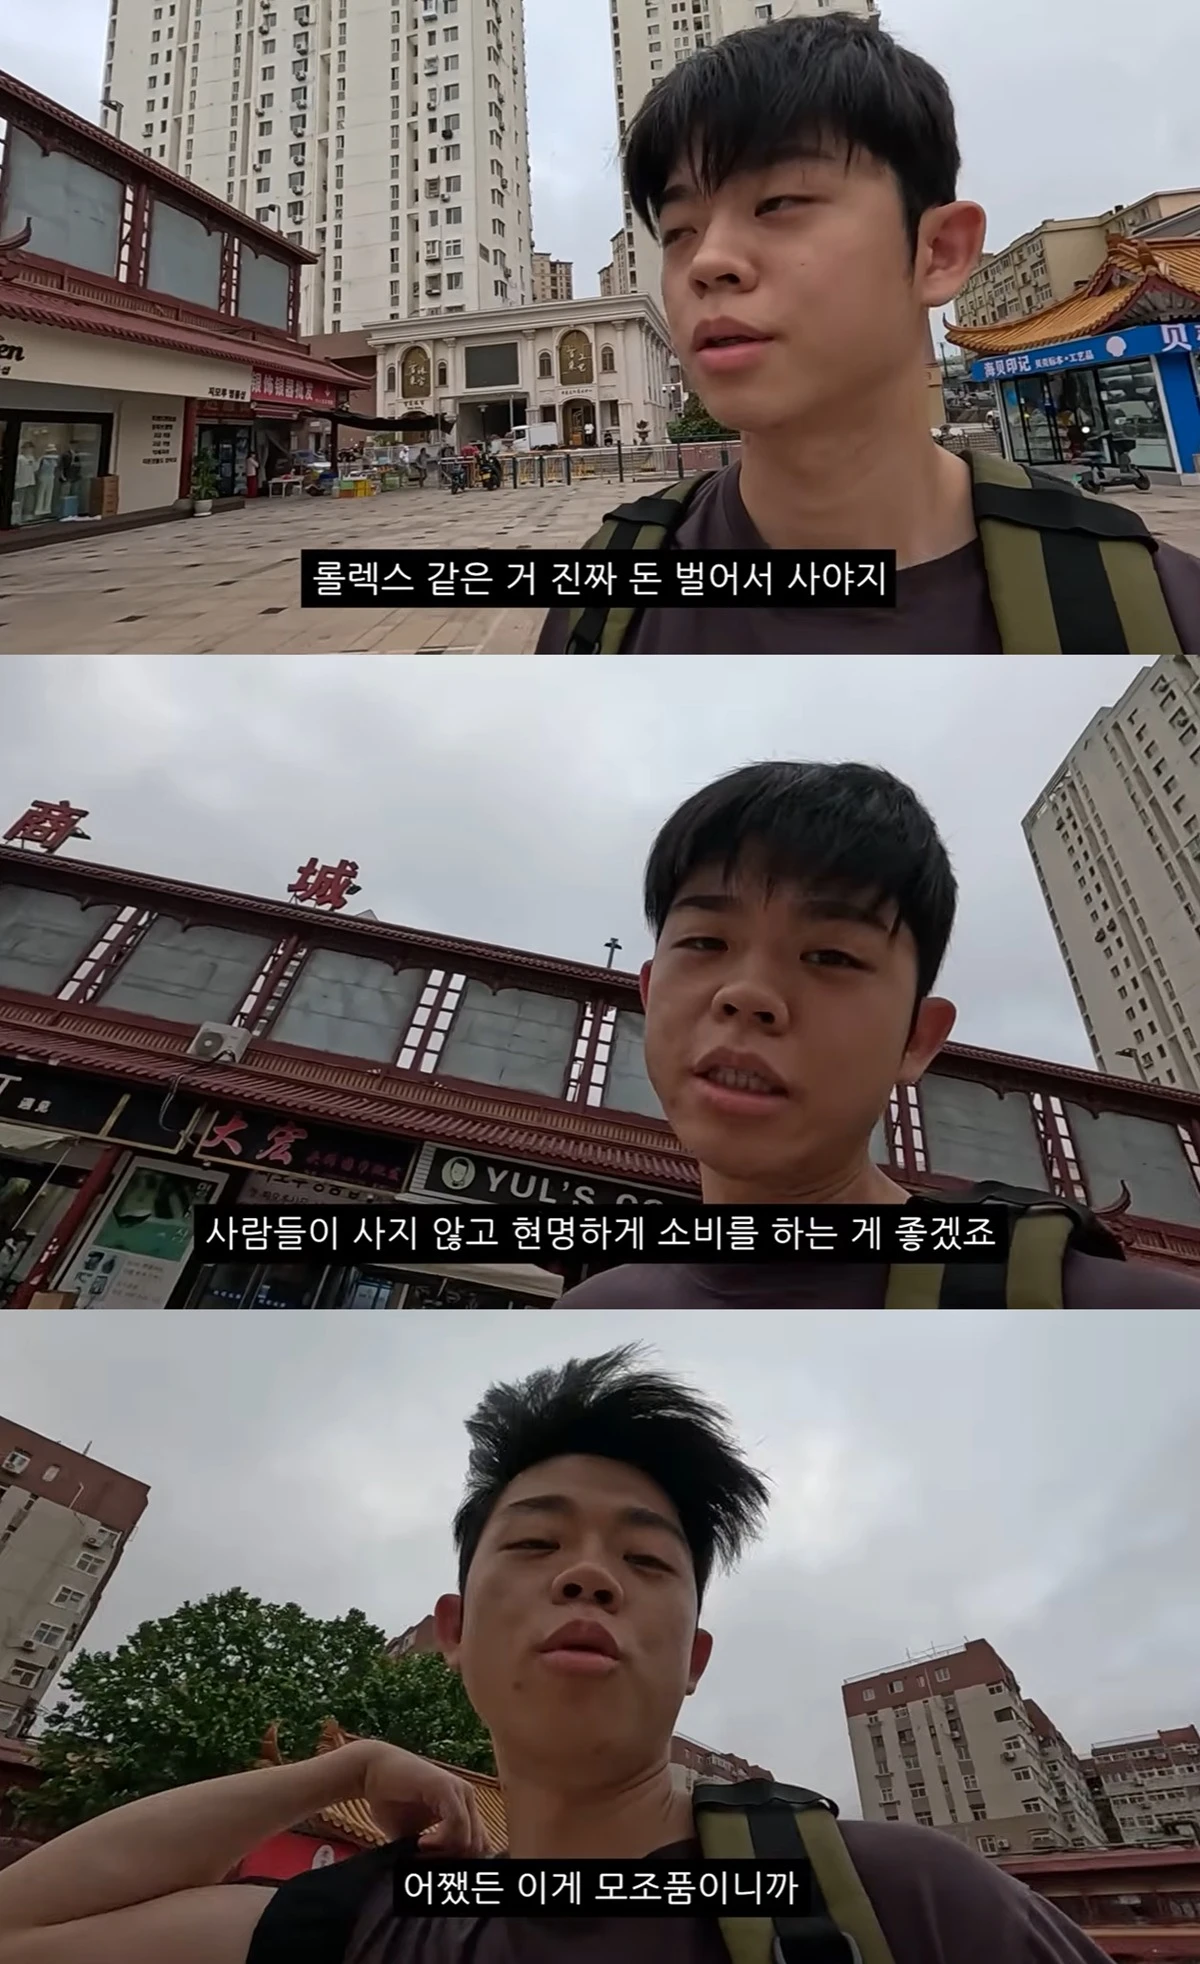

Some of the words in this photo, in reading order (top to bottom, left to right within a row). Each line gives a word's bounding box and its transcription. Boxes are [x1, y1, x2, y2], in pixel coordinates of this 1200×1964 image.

[1160, 323, 1200, 352] 贝
[984, 355, 1031, 378] 海贝印记
[252, 371, 315, 401] 银饰银器批发
[3, 800, 90, 852] 商
[287, 857, 359, 909] 城
